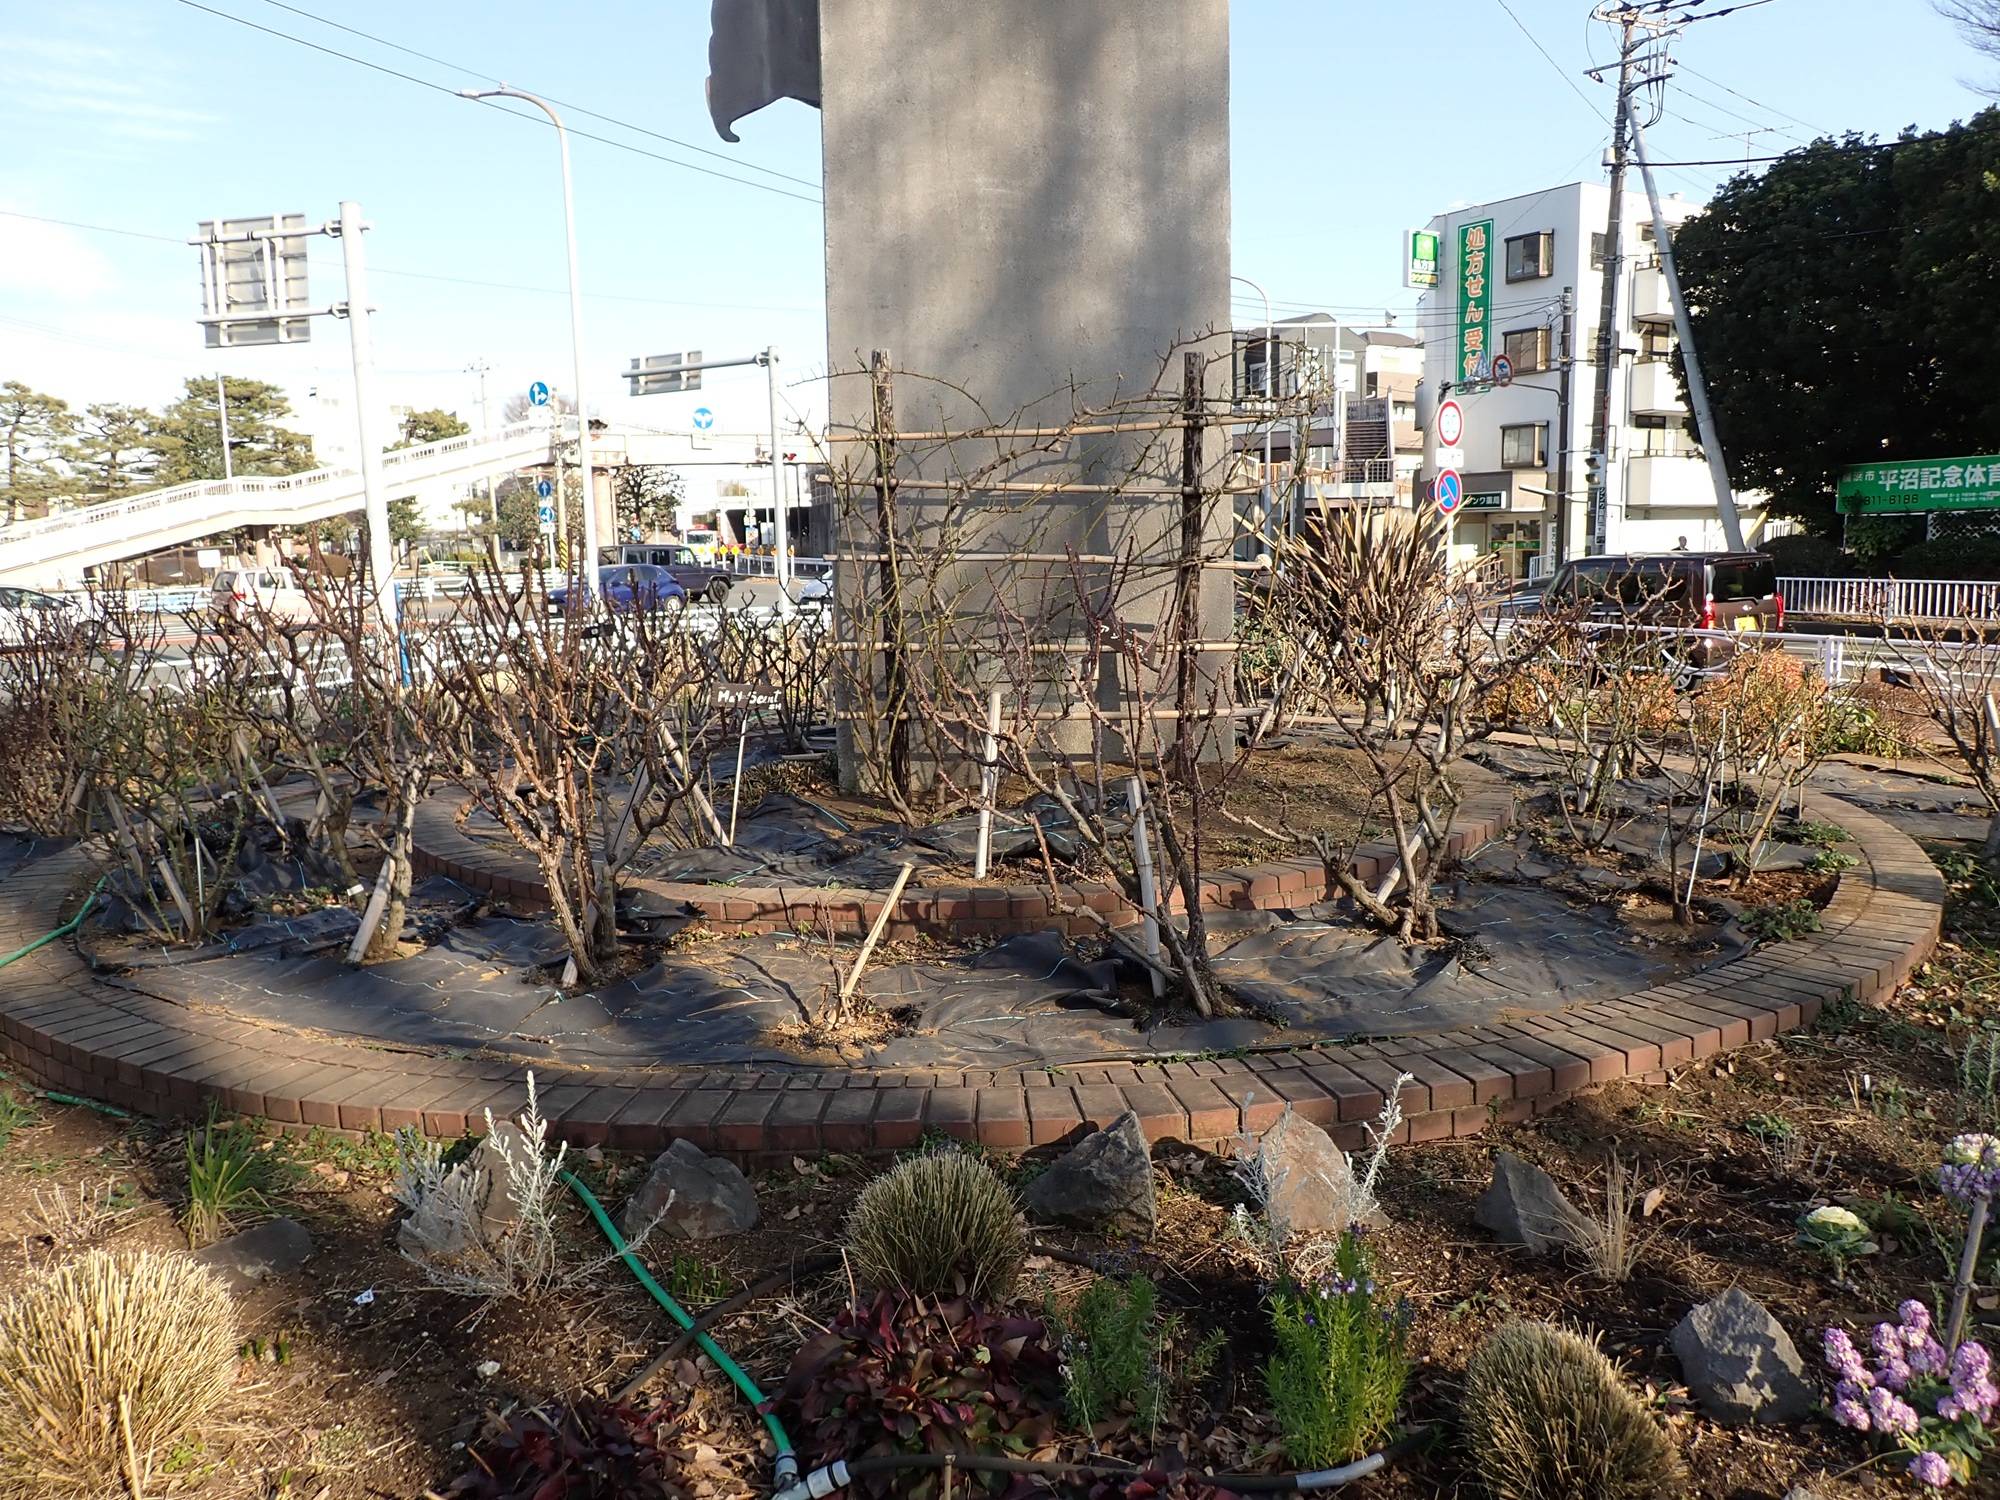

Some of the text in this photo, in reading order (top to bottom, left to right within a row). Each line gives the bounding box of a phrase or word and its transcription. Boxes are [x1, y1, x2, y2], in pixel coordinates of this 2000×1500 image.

[1463, 226, 1486, 377] 処方せん受付
